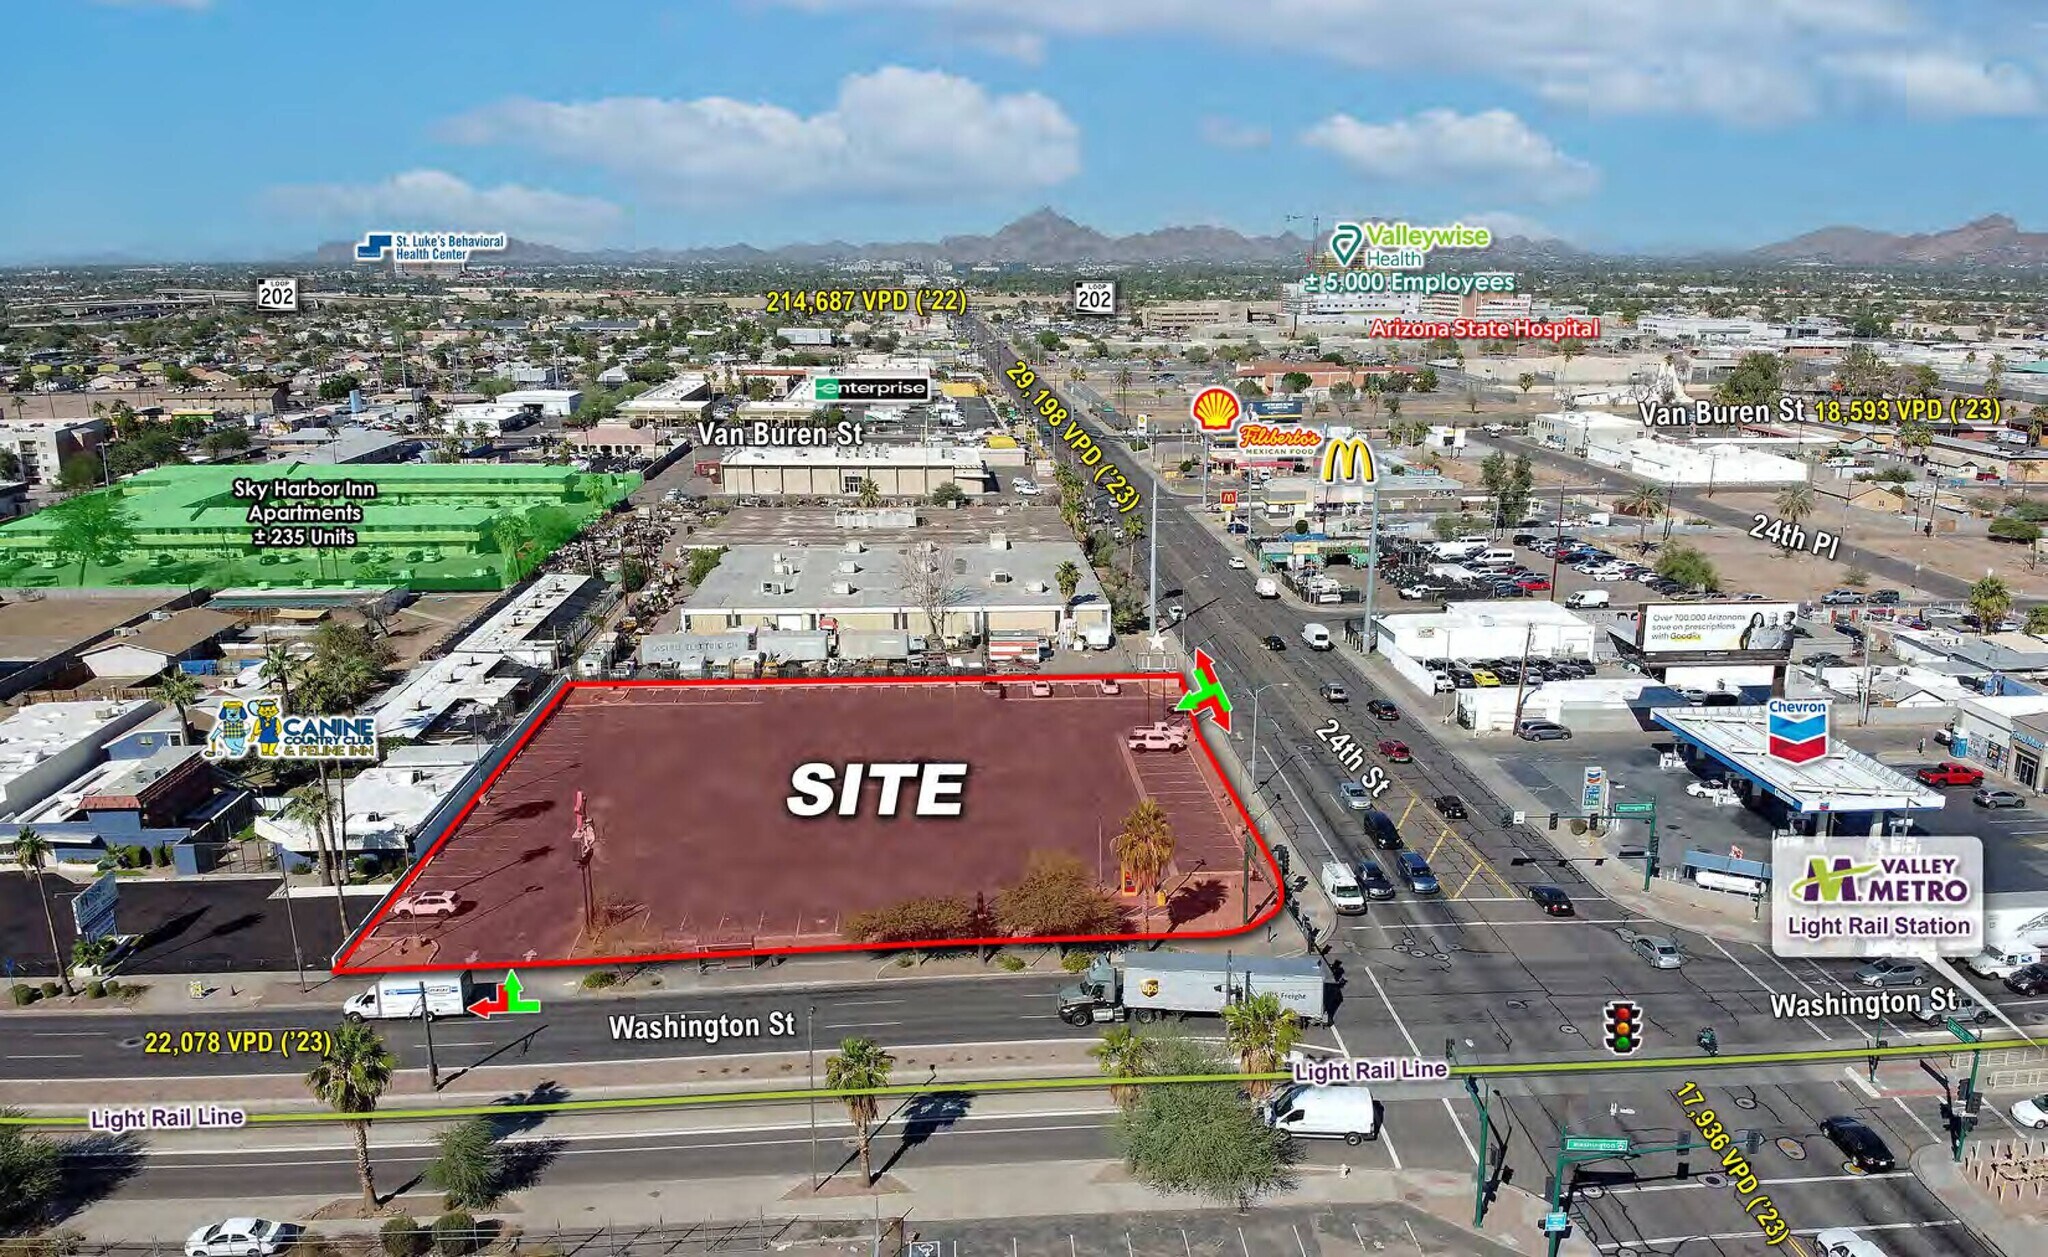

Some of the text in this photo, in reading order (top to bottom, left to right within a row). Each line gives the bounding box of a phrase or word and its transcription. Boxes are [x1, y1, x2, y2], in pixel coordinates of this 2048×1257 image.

[1653, 614, 1673, 622] Over
[1707, 613, 1746, 621] Arizonans
[1684, 622, 1736, 632] prescriptions
